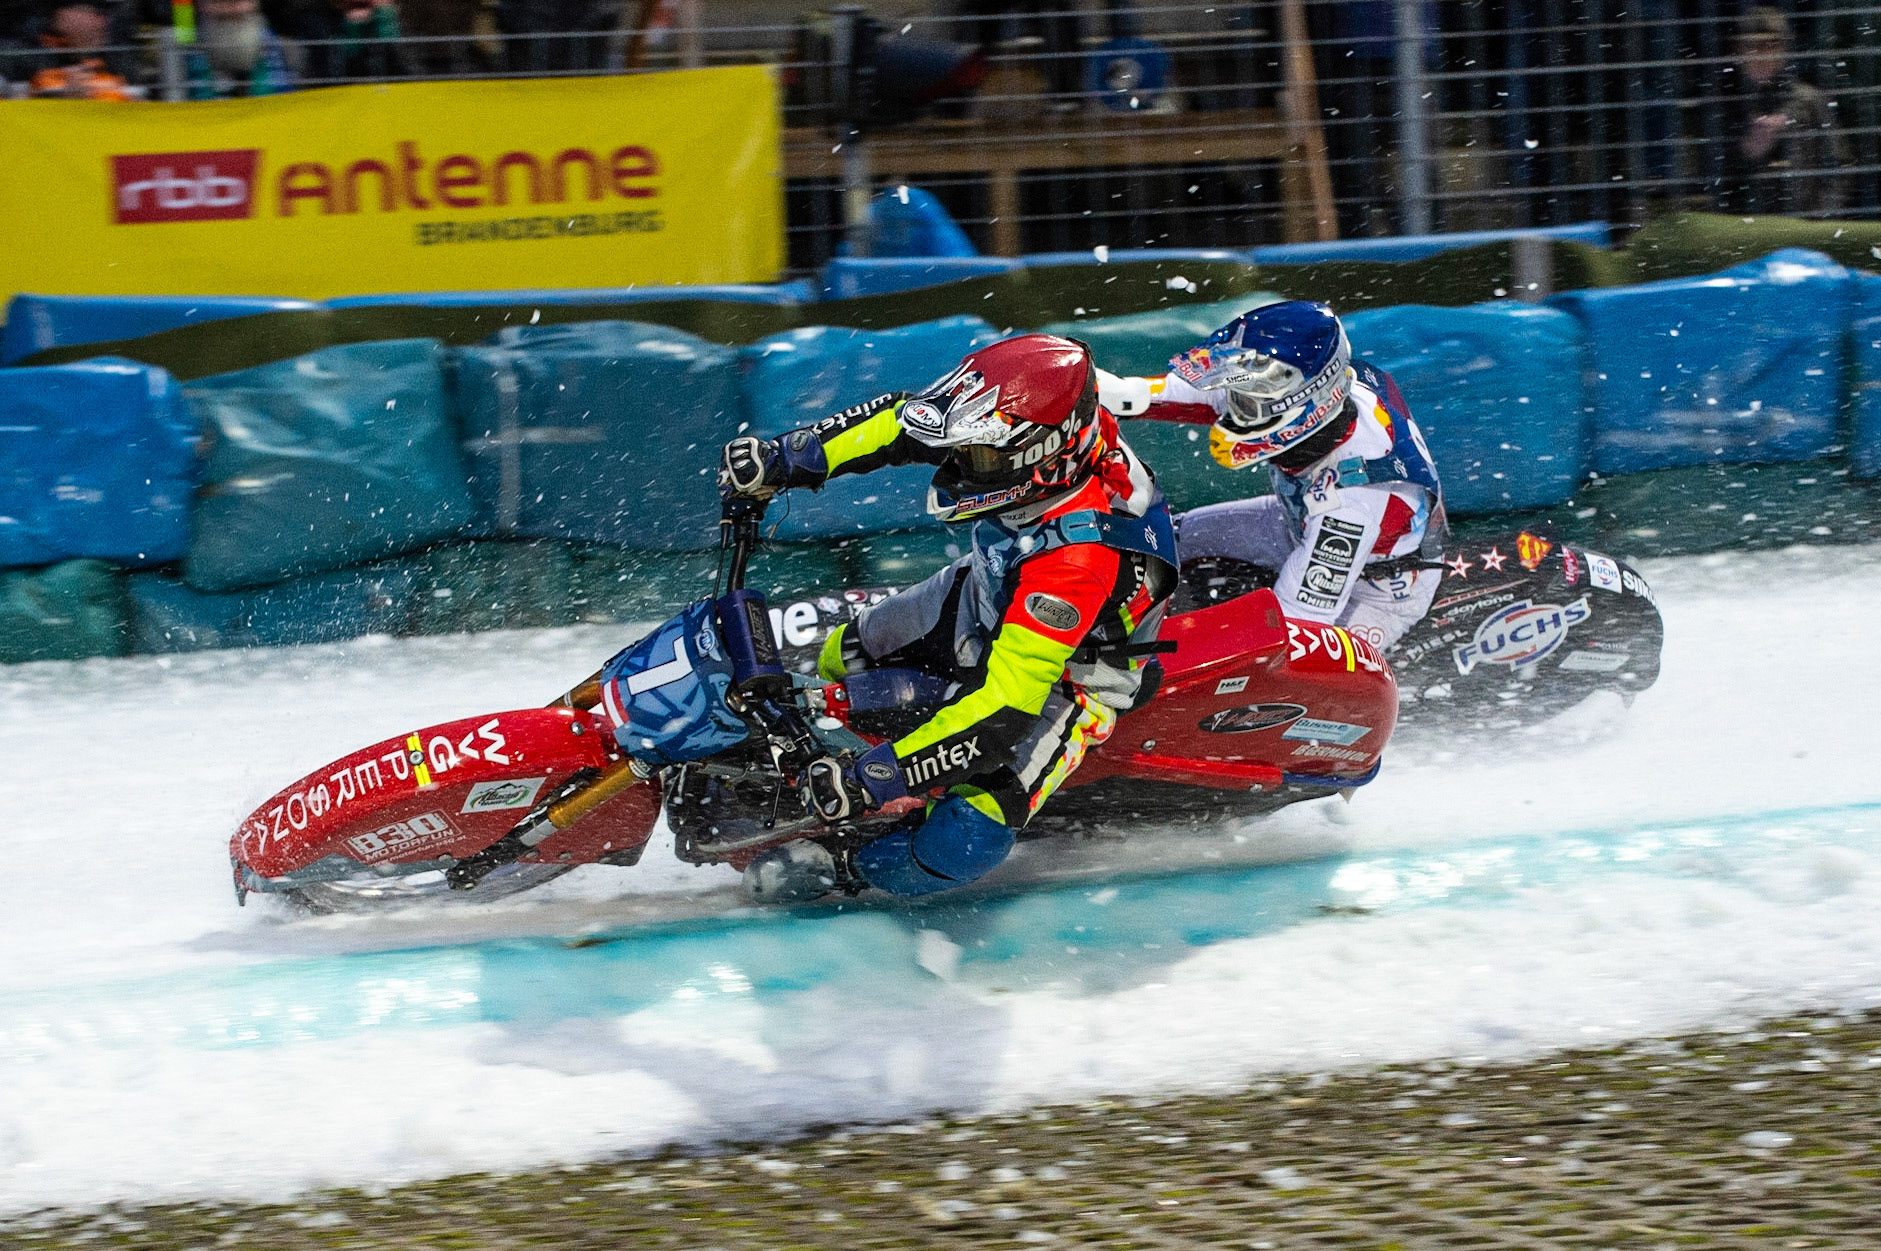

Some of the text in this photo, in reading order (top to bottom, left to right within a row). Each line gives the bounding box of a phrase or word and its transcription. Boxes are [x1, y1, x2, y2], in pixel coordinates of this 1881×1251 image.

[120, 166, 247, 211] rbb
[414, 208, 665, 246] BRANDENBURG
[1277, 416, 1317, 442] Red
[1592, 565, 1618, 578] FUCHS
[1457, 601, 1587, 669] FUCHS
